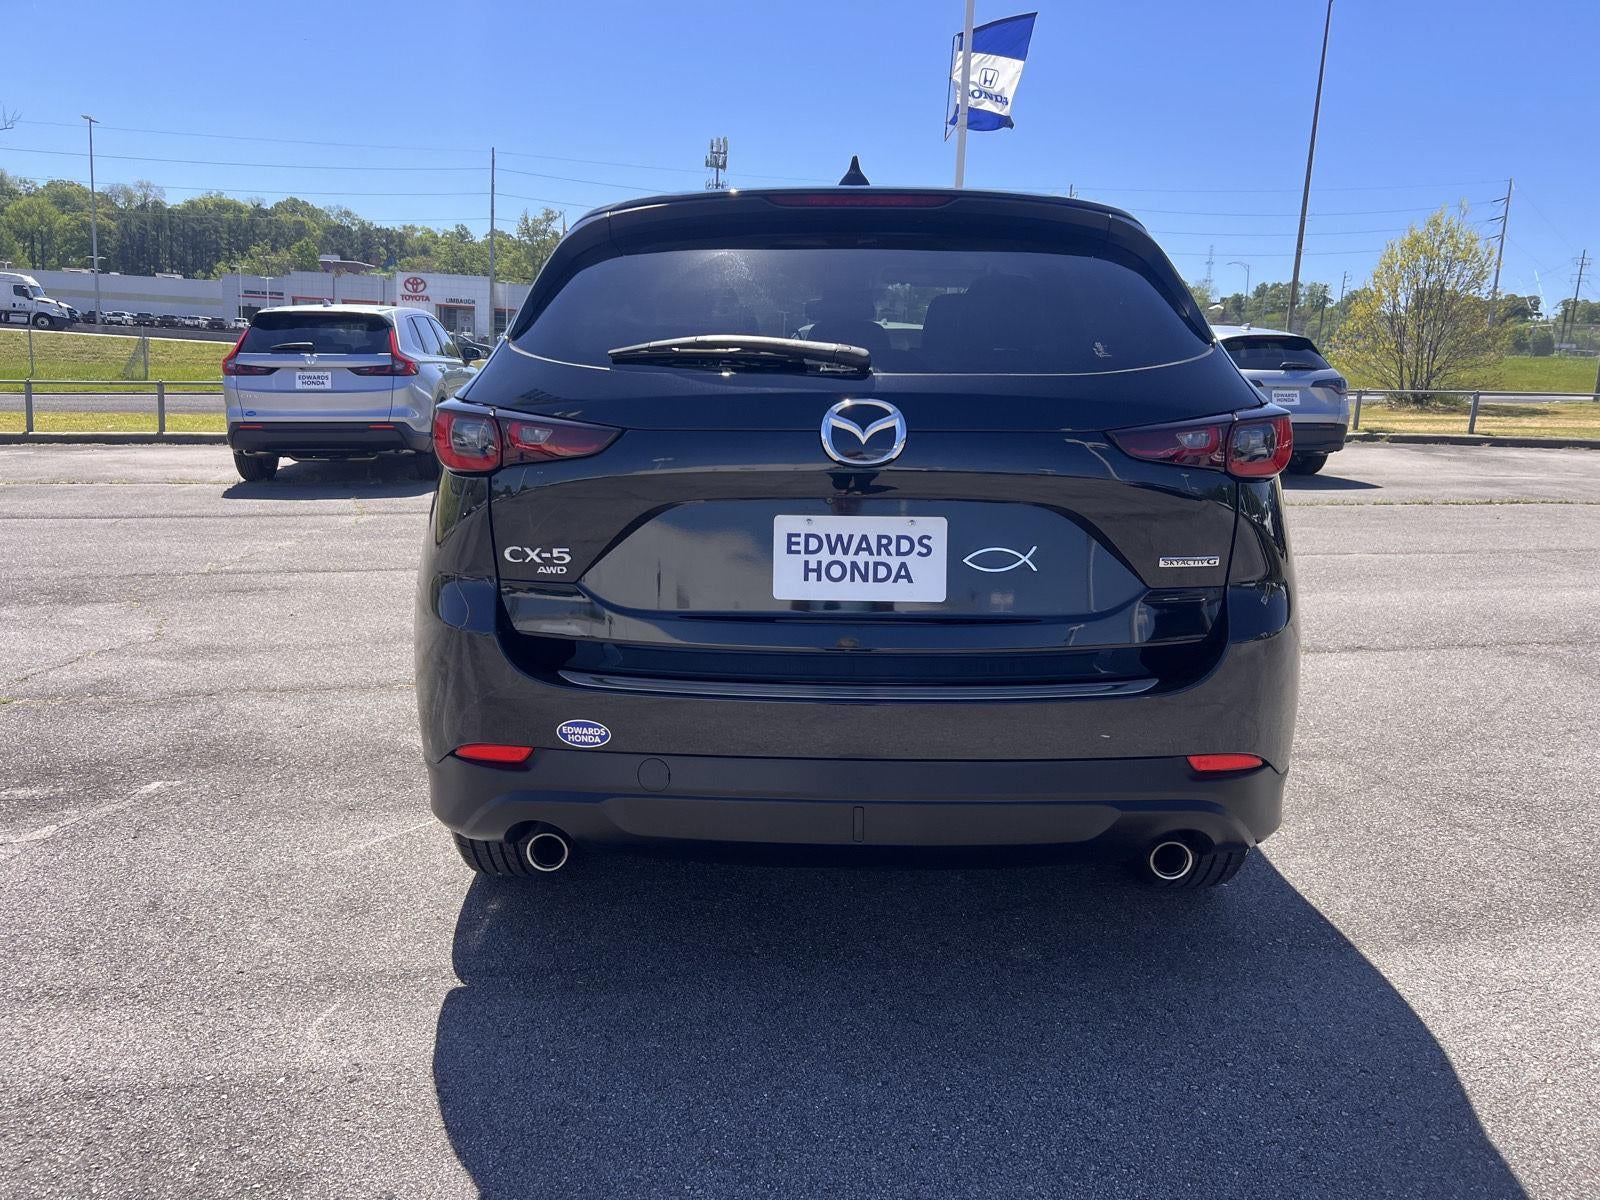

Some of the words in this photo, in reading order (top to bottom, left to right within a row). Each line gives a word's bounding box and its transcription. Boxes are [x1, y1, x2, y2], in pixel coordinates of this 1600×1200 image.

[400, 294, 431, 302] TOYOTA
[445, 297, 476, 305] LIMBAUGH
[786, 532, 933, 558] EDWARDS
[503, 545, 572, 564] CX-5
[536, 566, 568, 574] AWD
[803, 559, 914, 584] HONDA
[562, 726, 606, 735] EDWARDS
[567, 734, 601, 743] HONDA
